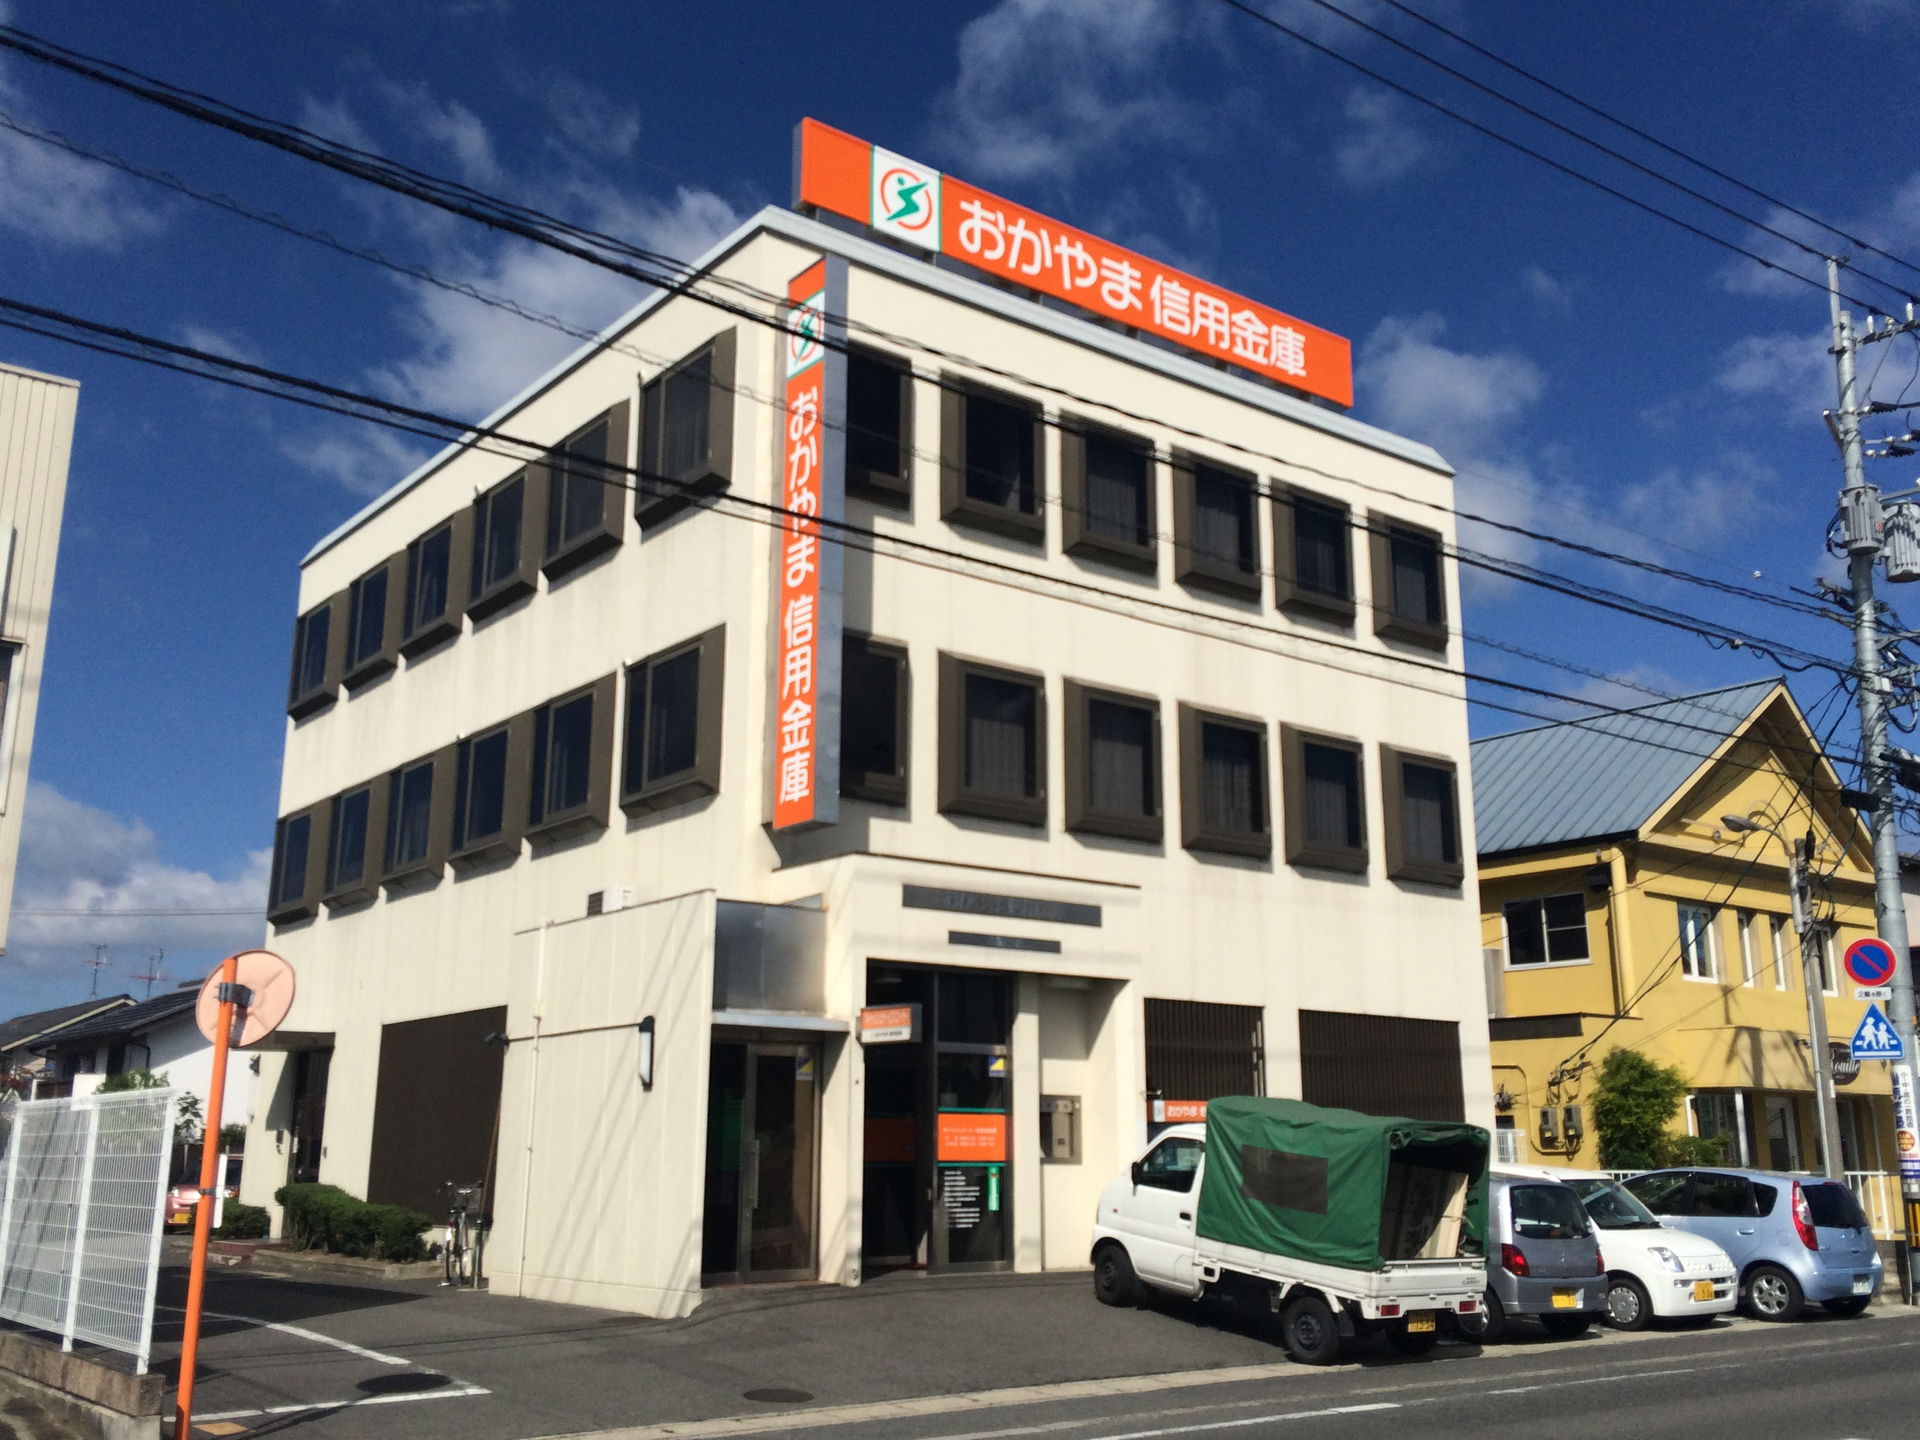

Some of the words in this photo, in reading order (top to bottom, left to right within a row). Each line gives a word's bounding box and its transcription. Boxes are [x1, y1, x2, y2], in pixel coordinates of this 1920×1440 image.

[959, 200, 1307, 377] おかやま信用金庫
[780, 387, 818, 803] おかやま信用金庫
